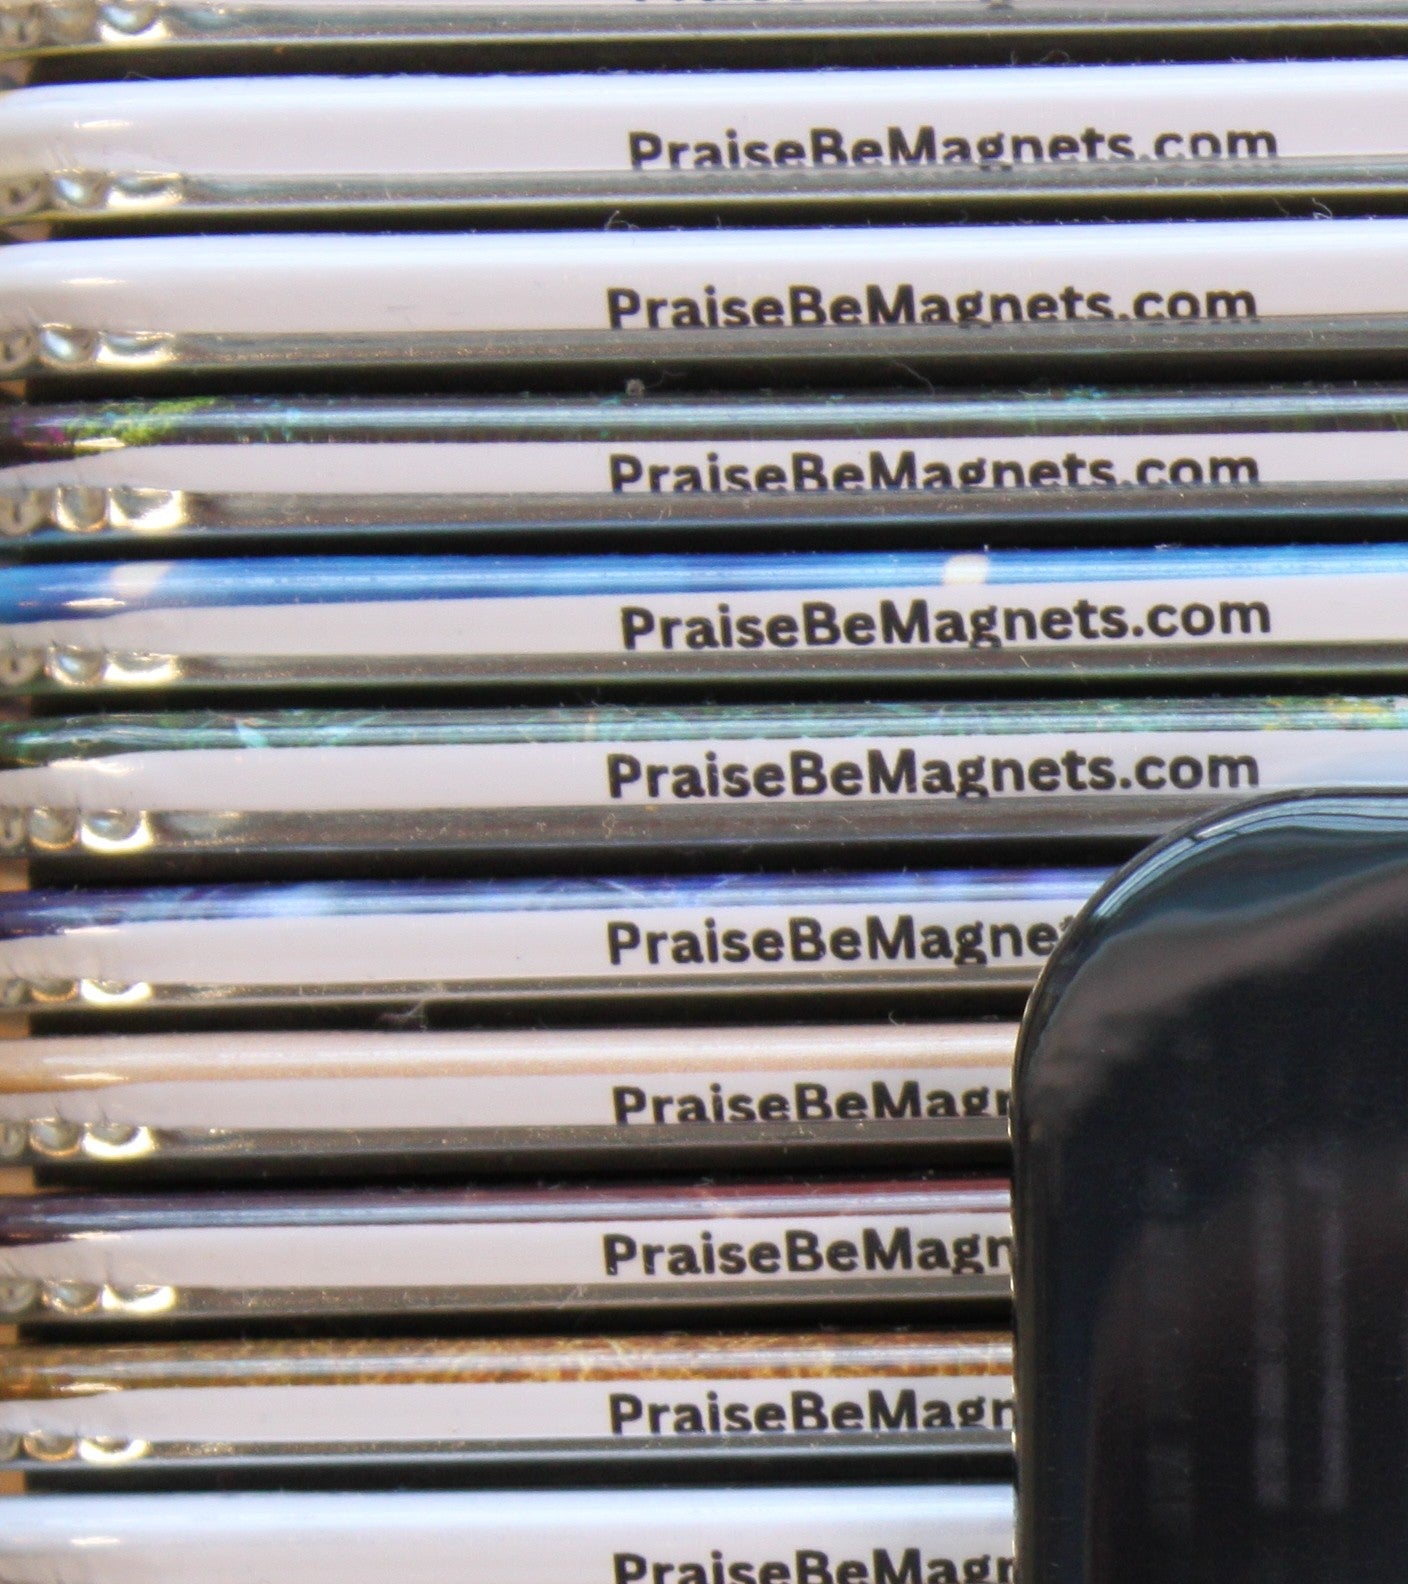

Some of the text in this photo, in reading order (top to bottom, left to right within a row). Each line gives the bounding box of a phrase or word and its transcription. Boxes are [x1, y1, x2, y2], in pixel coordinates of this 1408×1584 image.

[606, 284, 1258, 329] PraiseBeMagnets.com
[620, 597, 1272, 650] PraiseBeMagnets.com
[605, 747, 1261, 799] PraiseBeMagnets.com
